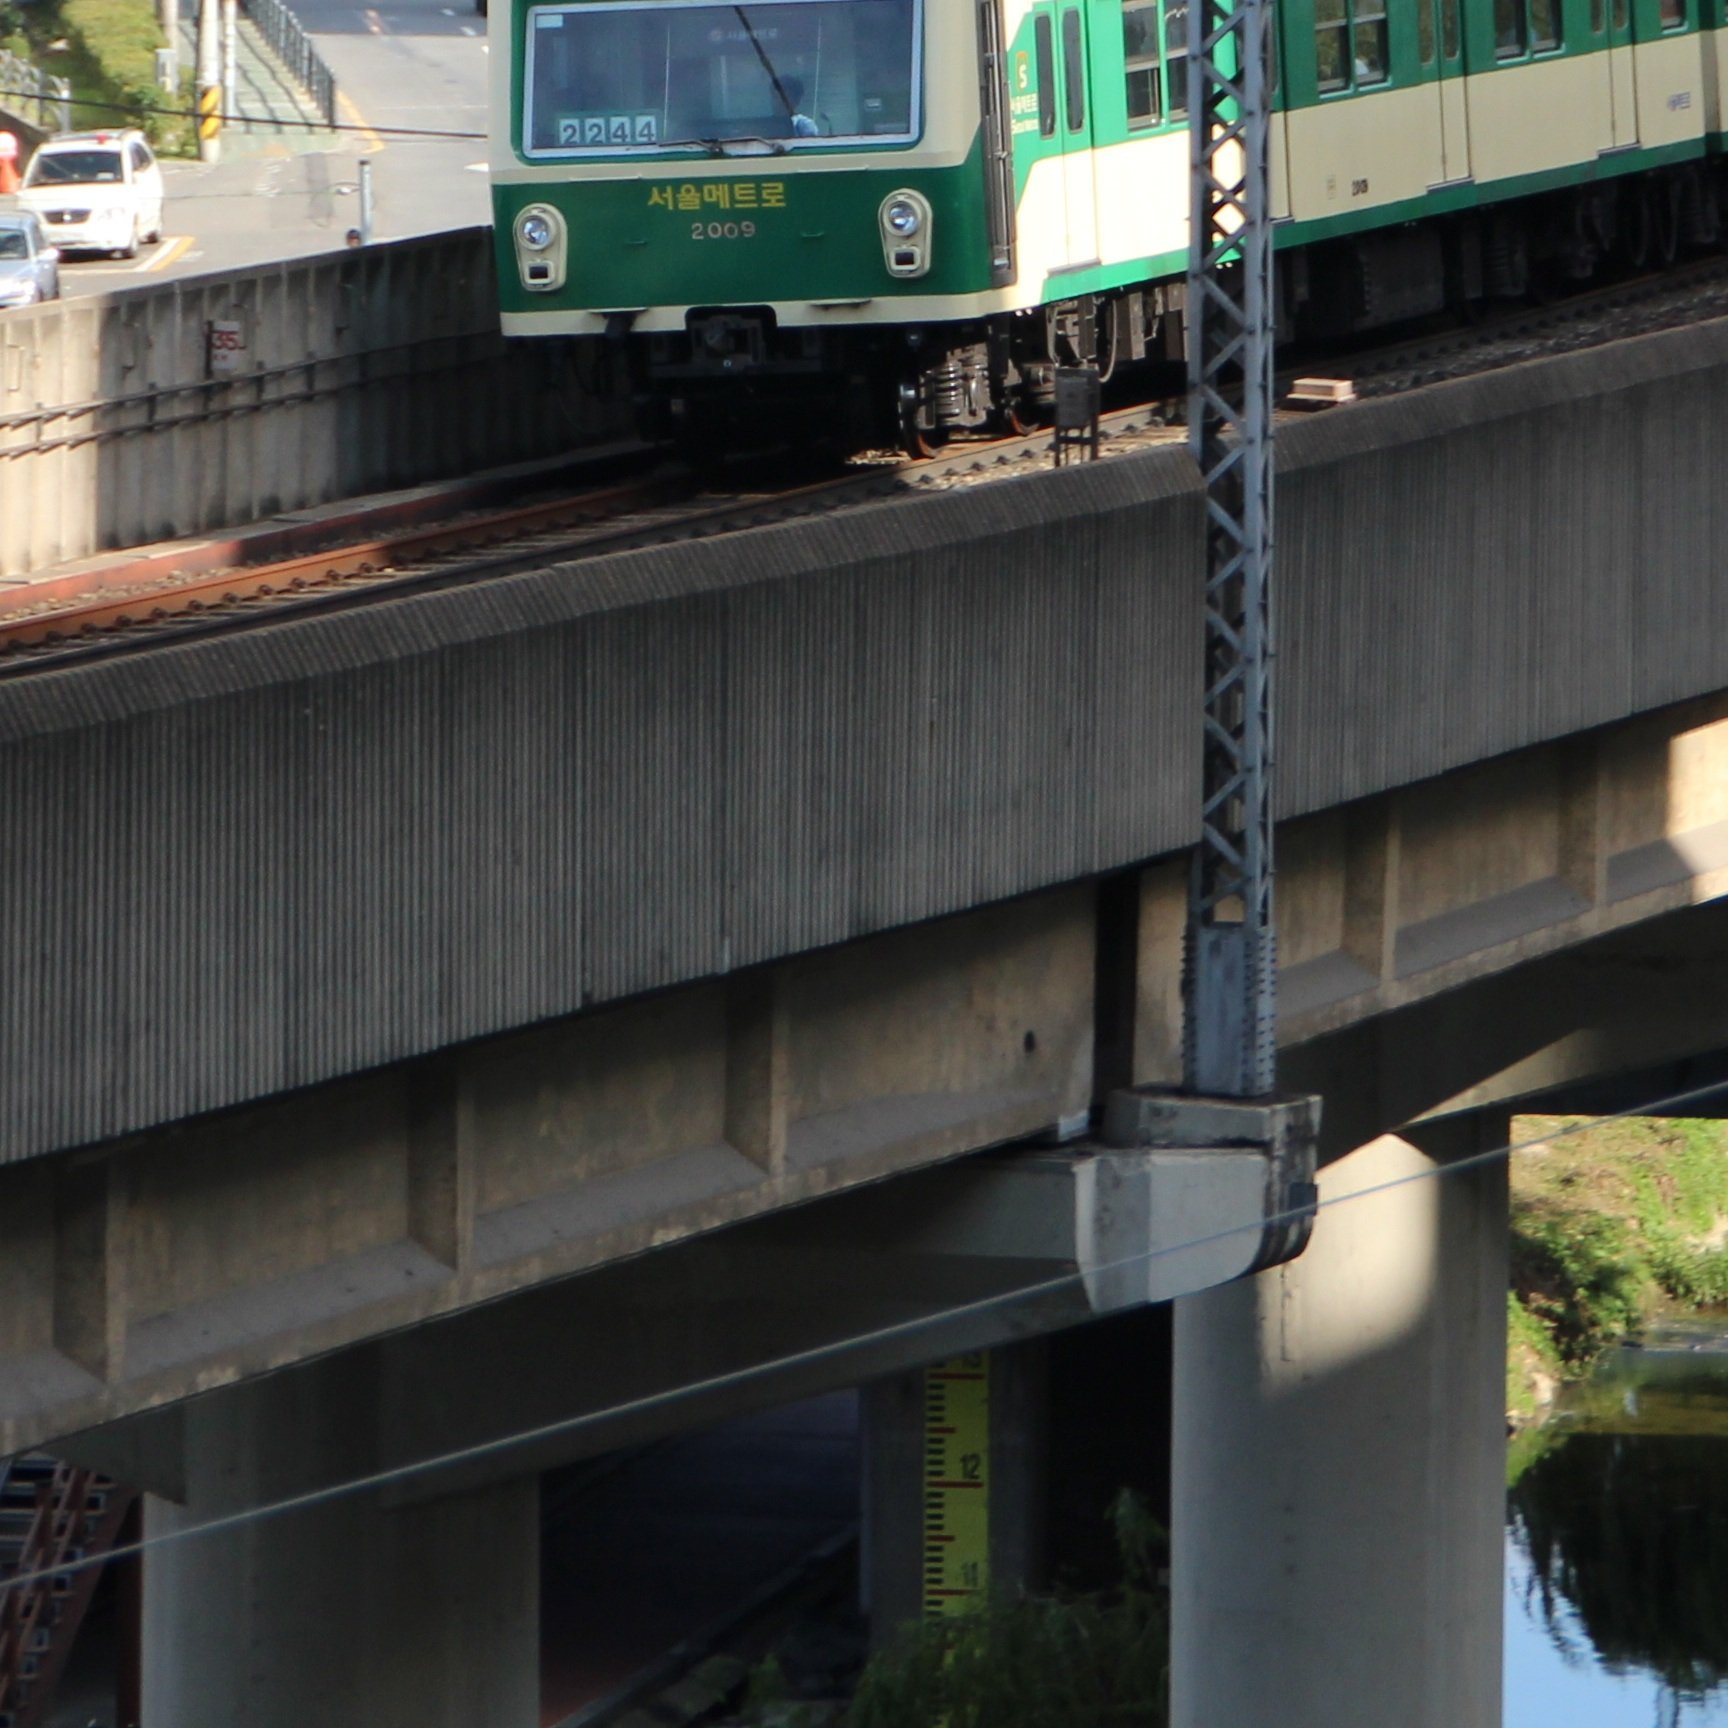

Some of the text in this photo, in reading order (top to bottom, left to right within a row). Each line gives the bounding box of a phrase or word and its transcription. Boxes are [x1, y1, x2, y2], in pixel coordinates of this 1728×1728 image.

[562, 118, 656, 144] 2244
[647, 182, 787, 211] 서울메트로
[691, 221, 756, 240] 2009
[960, 1452, 981, 1480] 12
